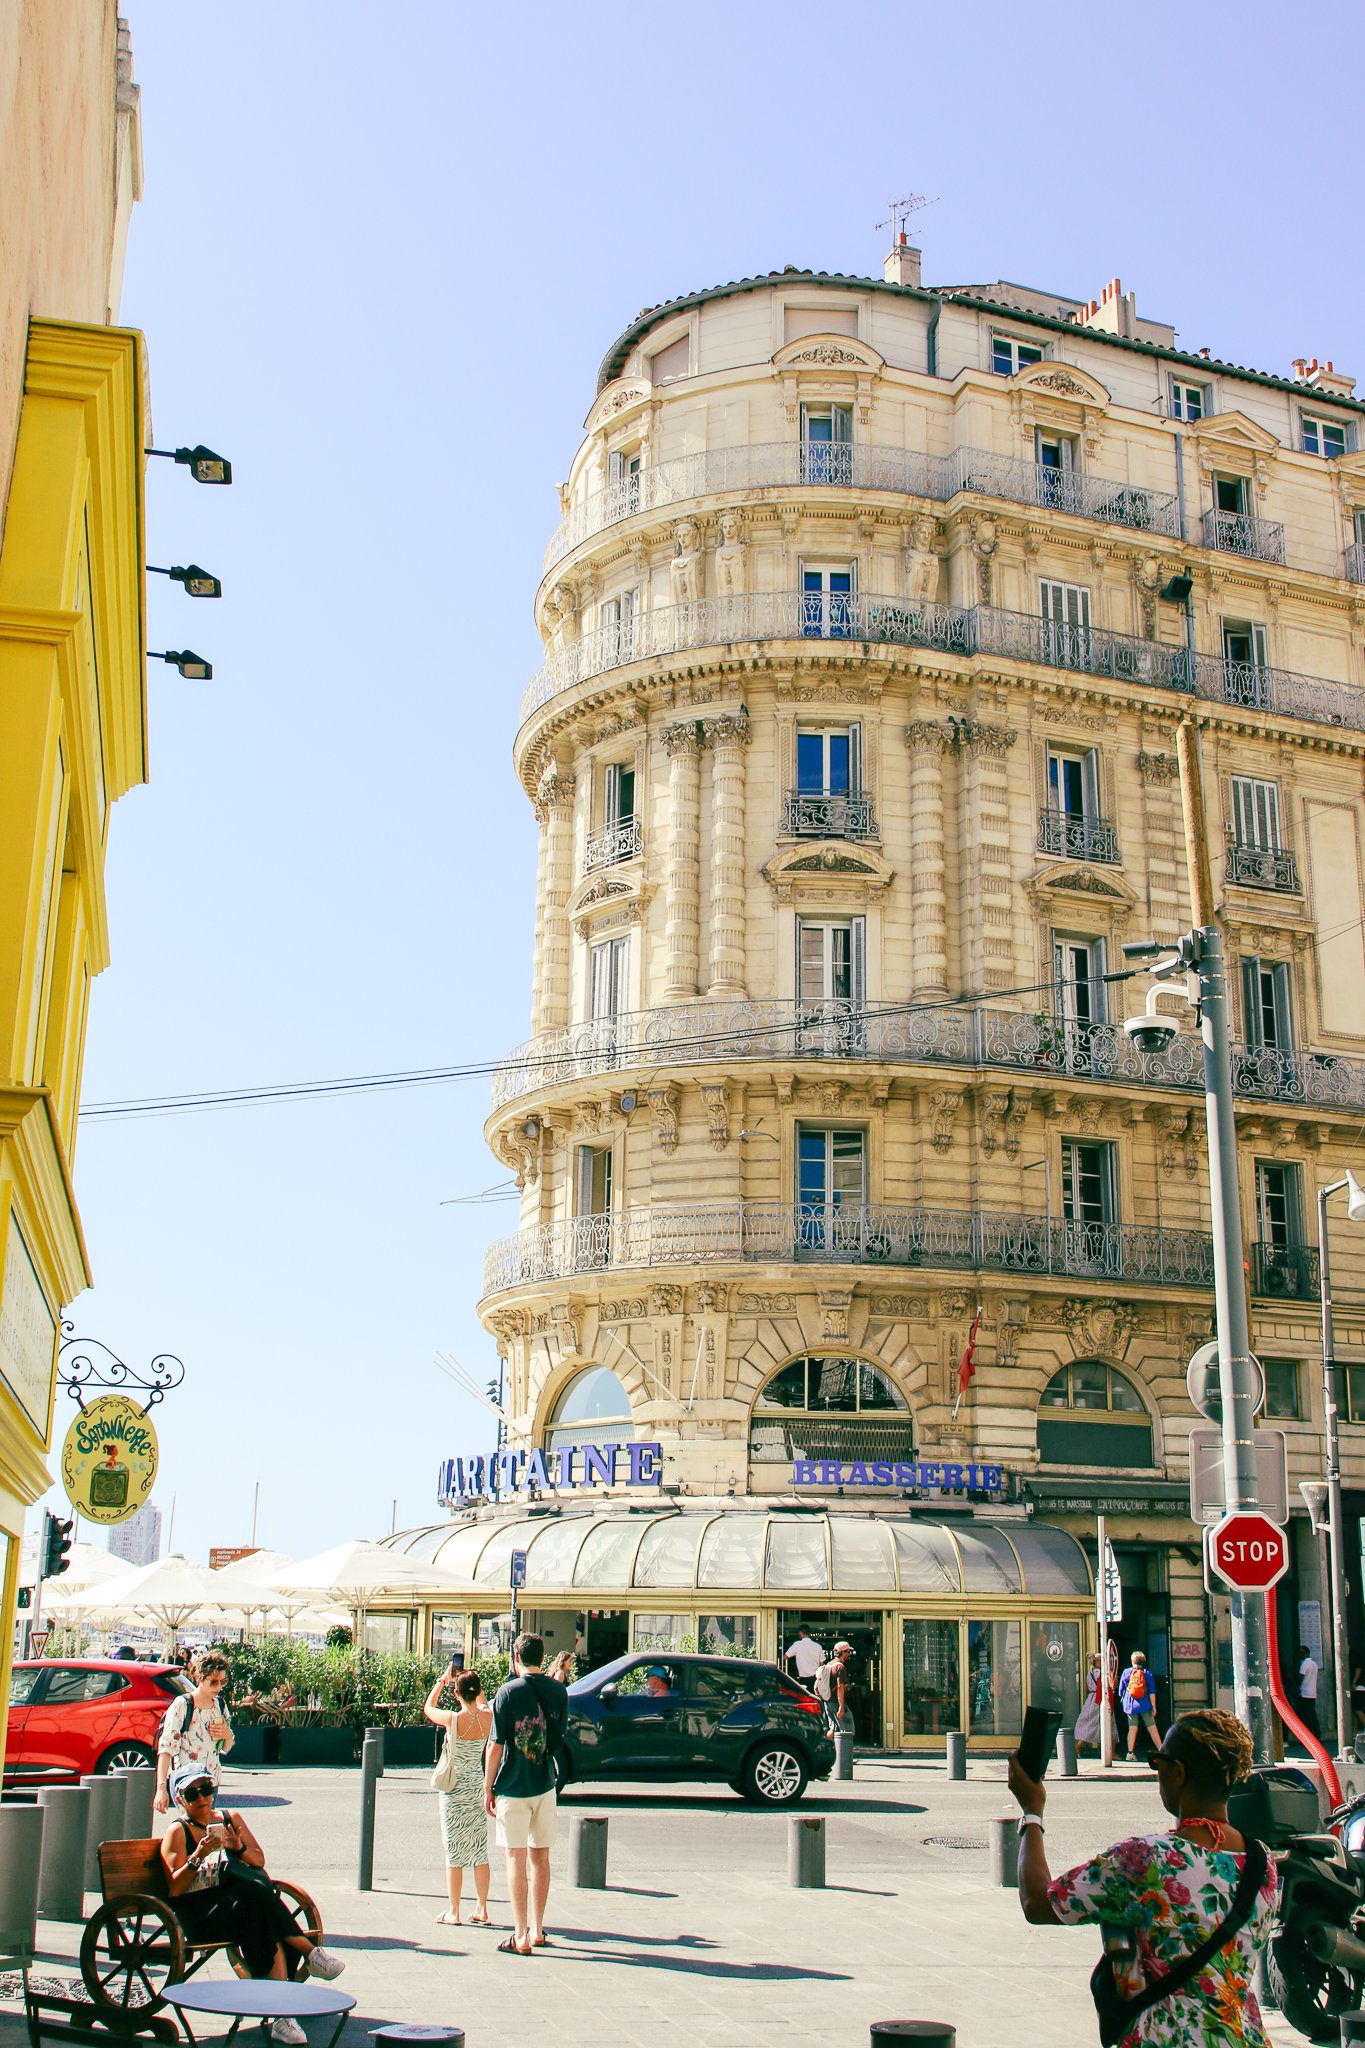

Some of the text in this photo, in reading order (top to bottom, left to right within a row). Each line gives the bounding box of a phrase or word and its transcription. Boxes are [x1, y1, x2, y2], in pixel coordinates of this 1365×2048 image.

[437, 1443, 662, 1500] MARITAINE
[791, 1460, 1002, 1491] BRASSERIE
[1222, 1541, 1279, 1562] STOP
[1174, 1643, 1201, 1656] ACAB
